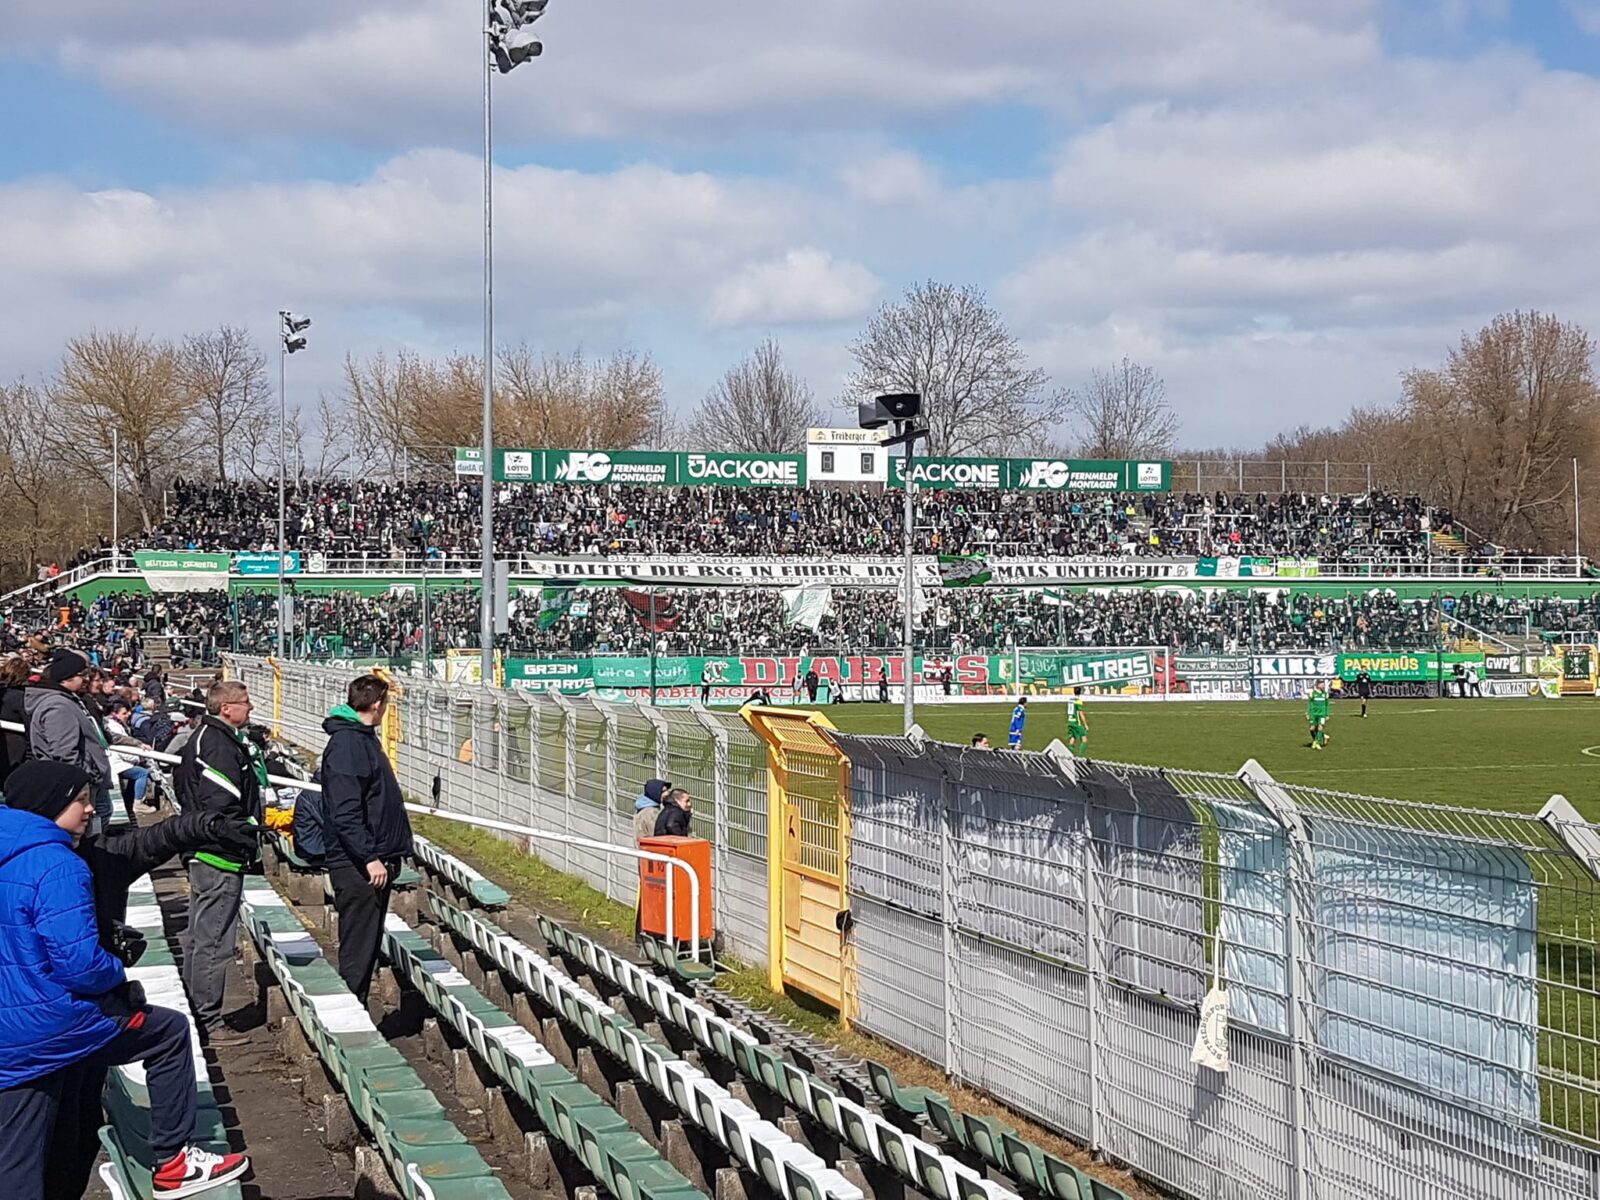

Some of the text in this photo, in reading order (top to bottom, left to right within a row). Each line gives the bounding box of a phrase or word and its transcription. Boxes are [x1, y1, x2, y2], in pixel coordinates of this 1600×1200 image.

[831, 430, 866, 443] Freiberger
[612, 464, 667, 473] FERNMELDE
[611, 473, 666, 482] MONTAGEN
[1070, 472, 1118, 481] FERNMELDE
[1068, 480, 1117, 489] MONTAGEN
[887, 556, 937, 564] LEIZIG
[554, 563, 640, 577] HALTET
[650, 564, 689, 577] DIE
[697, 565, 742, 577] BSG
[750, 565, 773, 577] IN
[1055, 564, 1172, 578] UNTERGEHT
[1062, 655, 1149, 685] ULTRAS
[1486, 657, 1511, 670] GWP
[738, 656, 989, 686] DIABLS
[1492, 682, 1529, 695] WURZEN
